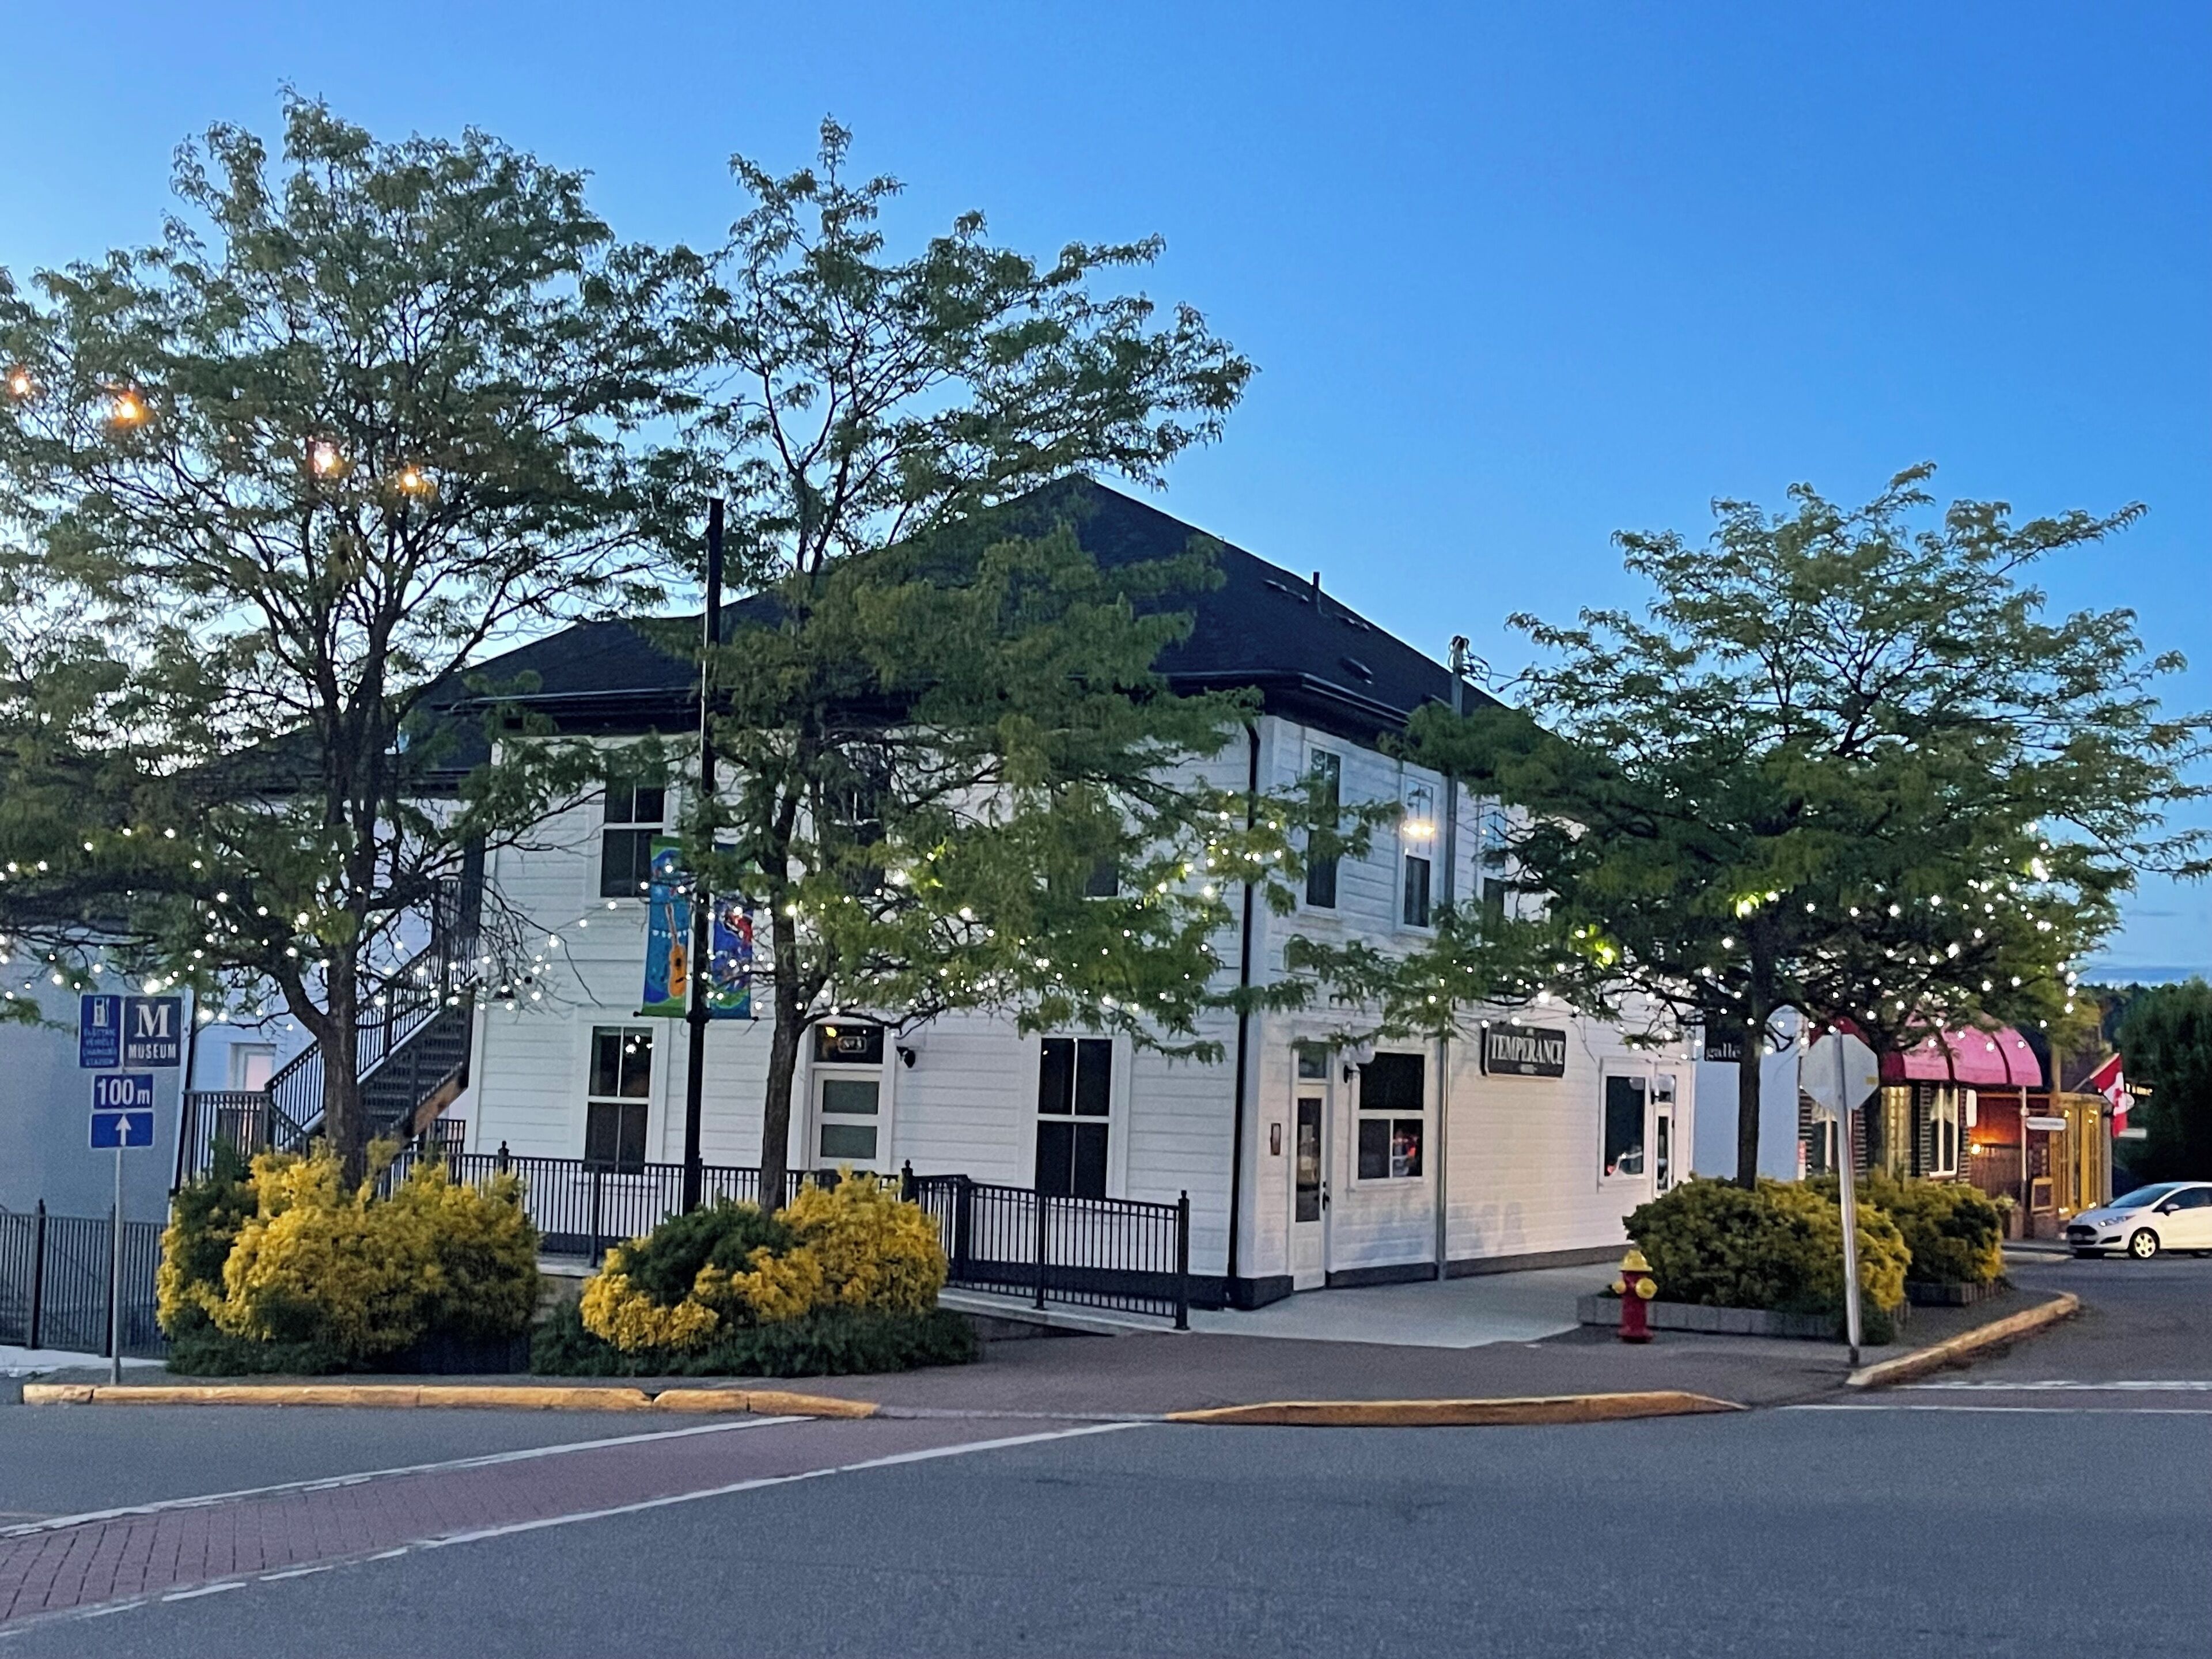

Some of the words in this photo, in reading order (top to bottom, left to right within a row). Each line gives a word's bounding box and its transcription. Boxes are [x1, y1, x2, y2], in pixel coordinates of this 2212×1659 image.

[134, 1004, 172, 1037] M
[128, 1043, 176, 1059] MUSEUM
[1491, 1033, 1565, 1065] TEMPERANCE
[1706, 1042, 1741, 1060] galle
